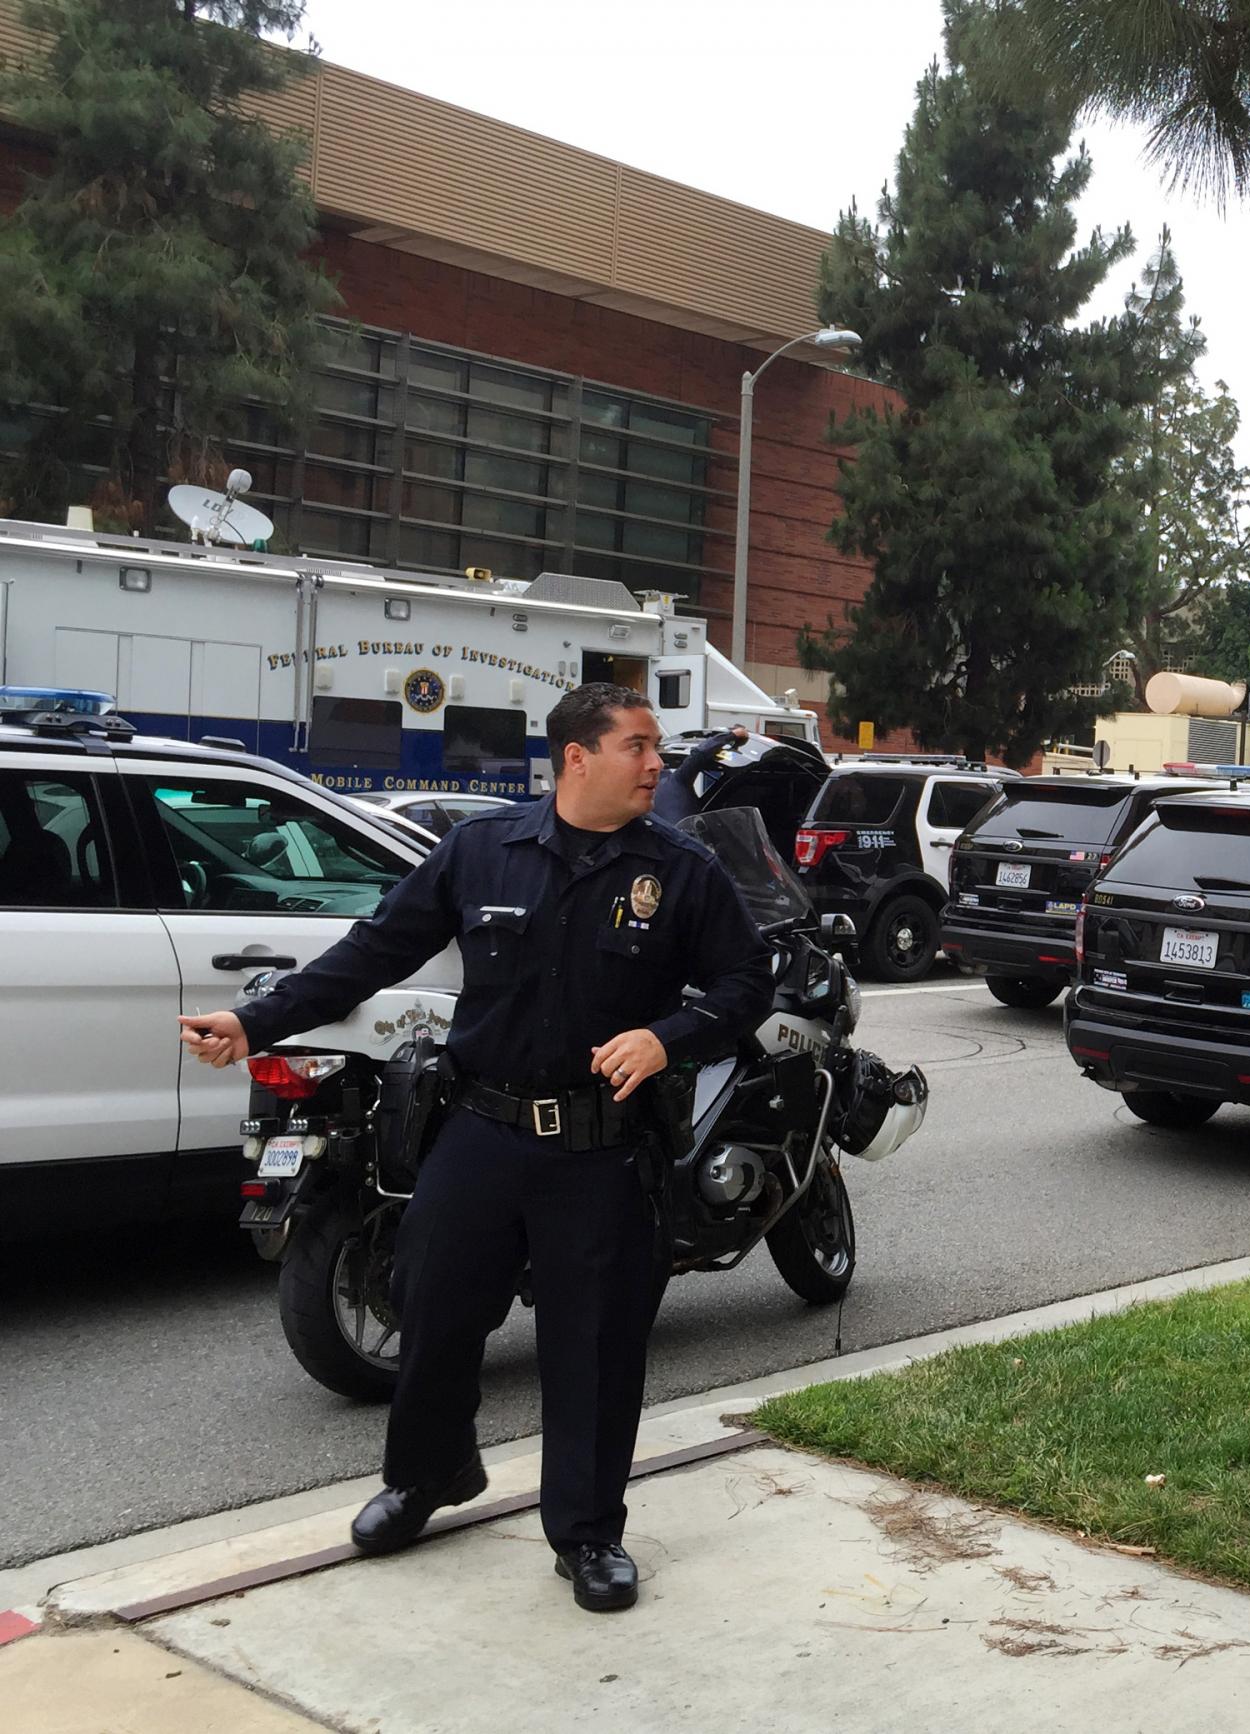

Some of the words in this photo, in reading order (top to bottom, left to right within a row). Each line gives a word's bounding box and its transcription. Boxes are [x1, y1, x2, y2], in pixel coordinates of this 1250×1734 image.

[357, 639, 424, 656] BUREAU
[432, 644, 453, 658] OF
[461, 646, 575, 692] INVESTIGATION
[311, 773, 373, 789] MOBILE
[384, 776, 460, 791] COMMAND
[469, 779, 526, 793] CENTER
[1164, 941, 1213, 964] 1453813
